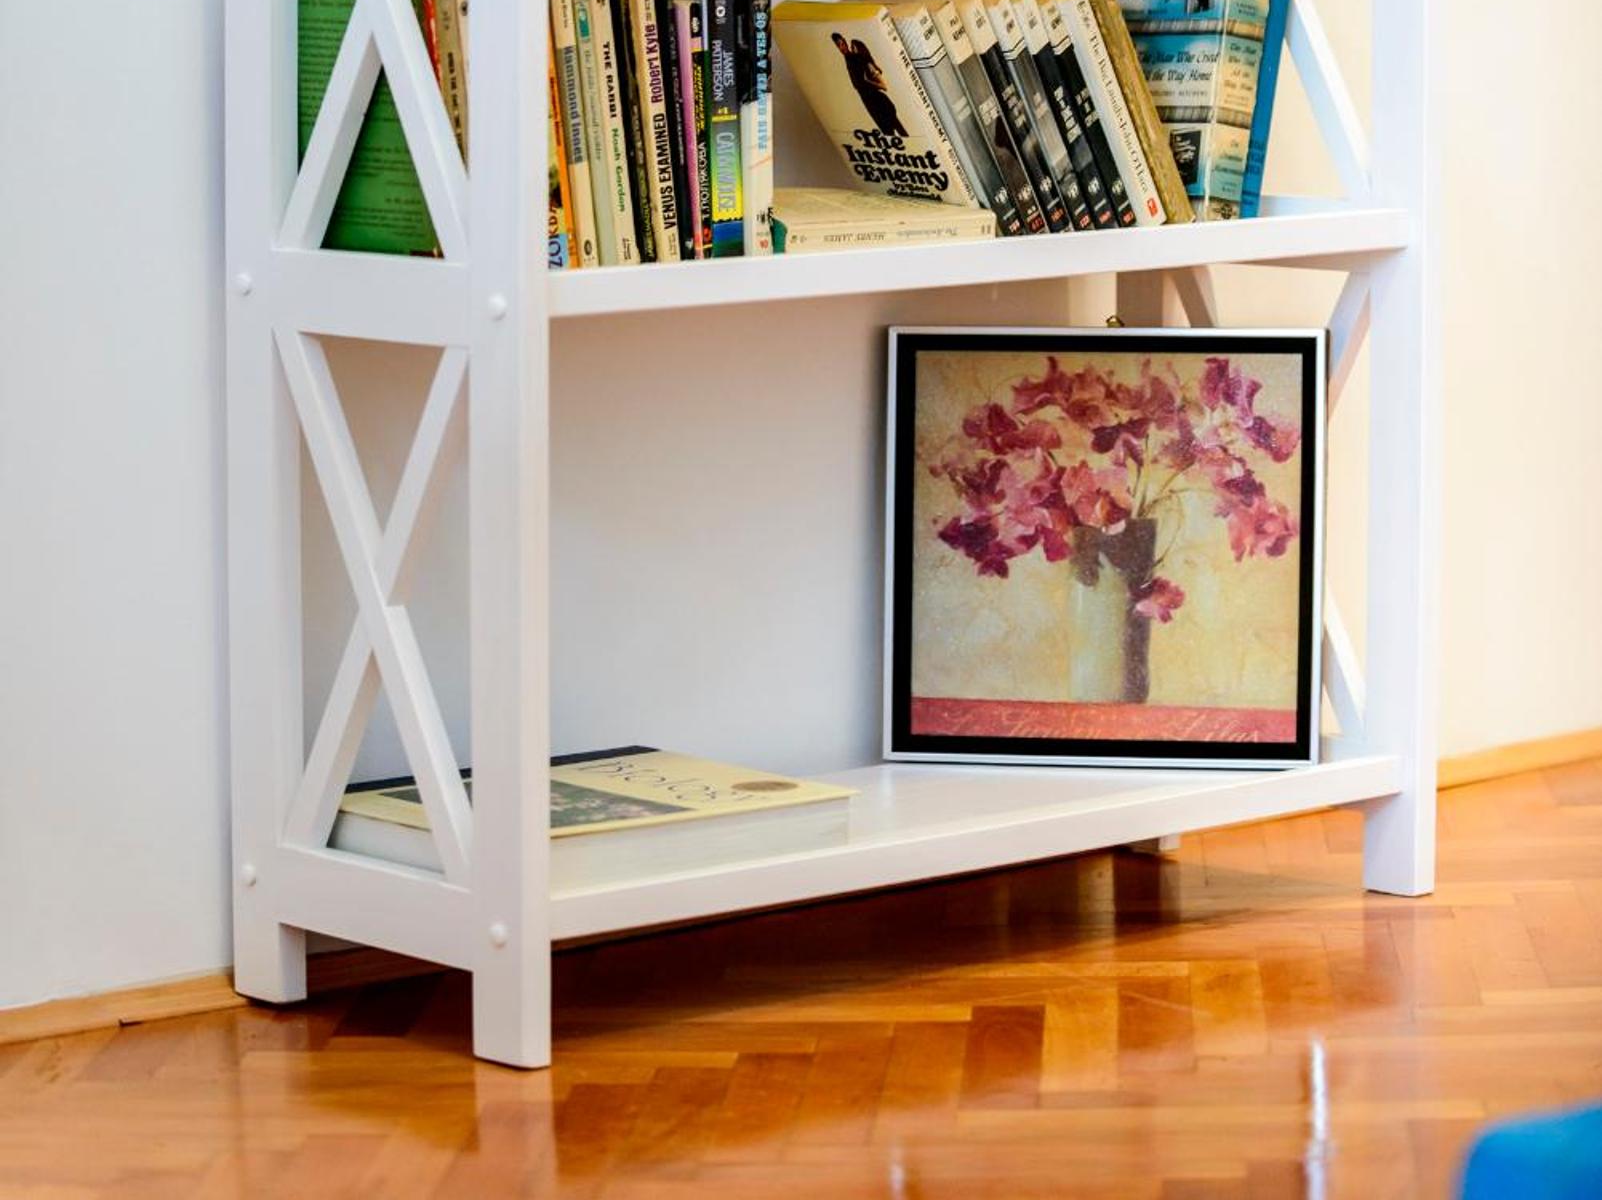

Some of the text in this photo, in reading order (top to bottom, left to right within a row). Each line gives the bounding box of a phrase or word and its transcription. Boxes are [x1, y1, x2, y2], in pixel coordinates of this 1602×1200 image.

[645, 23, 661, 54] Kyle
[755, 12, 768, 29] OS
[756, 31, 767, 57] TES
[563, 46, 581, 120] Hammond
[602, 41, 618, 120] THE RABBI
[649, 55, 665, 103] Robert
[711, 39, 724, 102] PATTERSON
[723, 51, 736, 87] JAMES
[899, 50, 910, 67] THE
[908, 67, 931, 109] INSTANT
[927, 108, 949, 144] ENEMY
[570, 122, 584, 164] Innes
[652, 111, 672, 178] EXAMINED
[716, 131, 736, 153] CAT
[842, 143, 940, 170] Instant
[854, 129, 905, 151] The
[611, 127, 626, 213] Noah Gordon
[854, 163, 948, 191] Enemy
[657, 178, 677, 231] VENUS
[823, 232, 886, 243] HENRY JAMES
